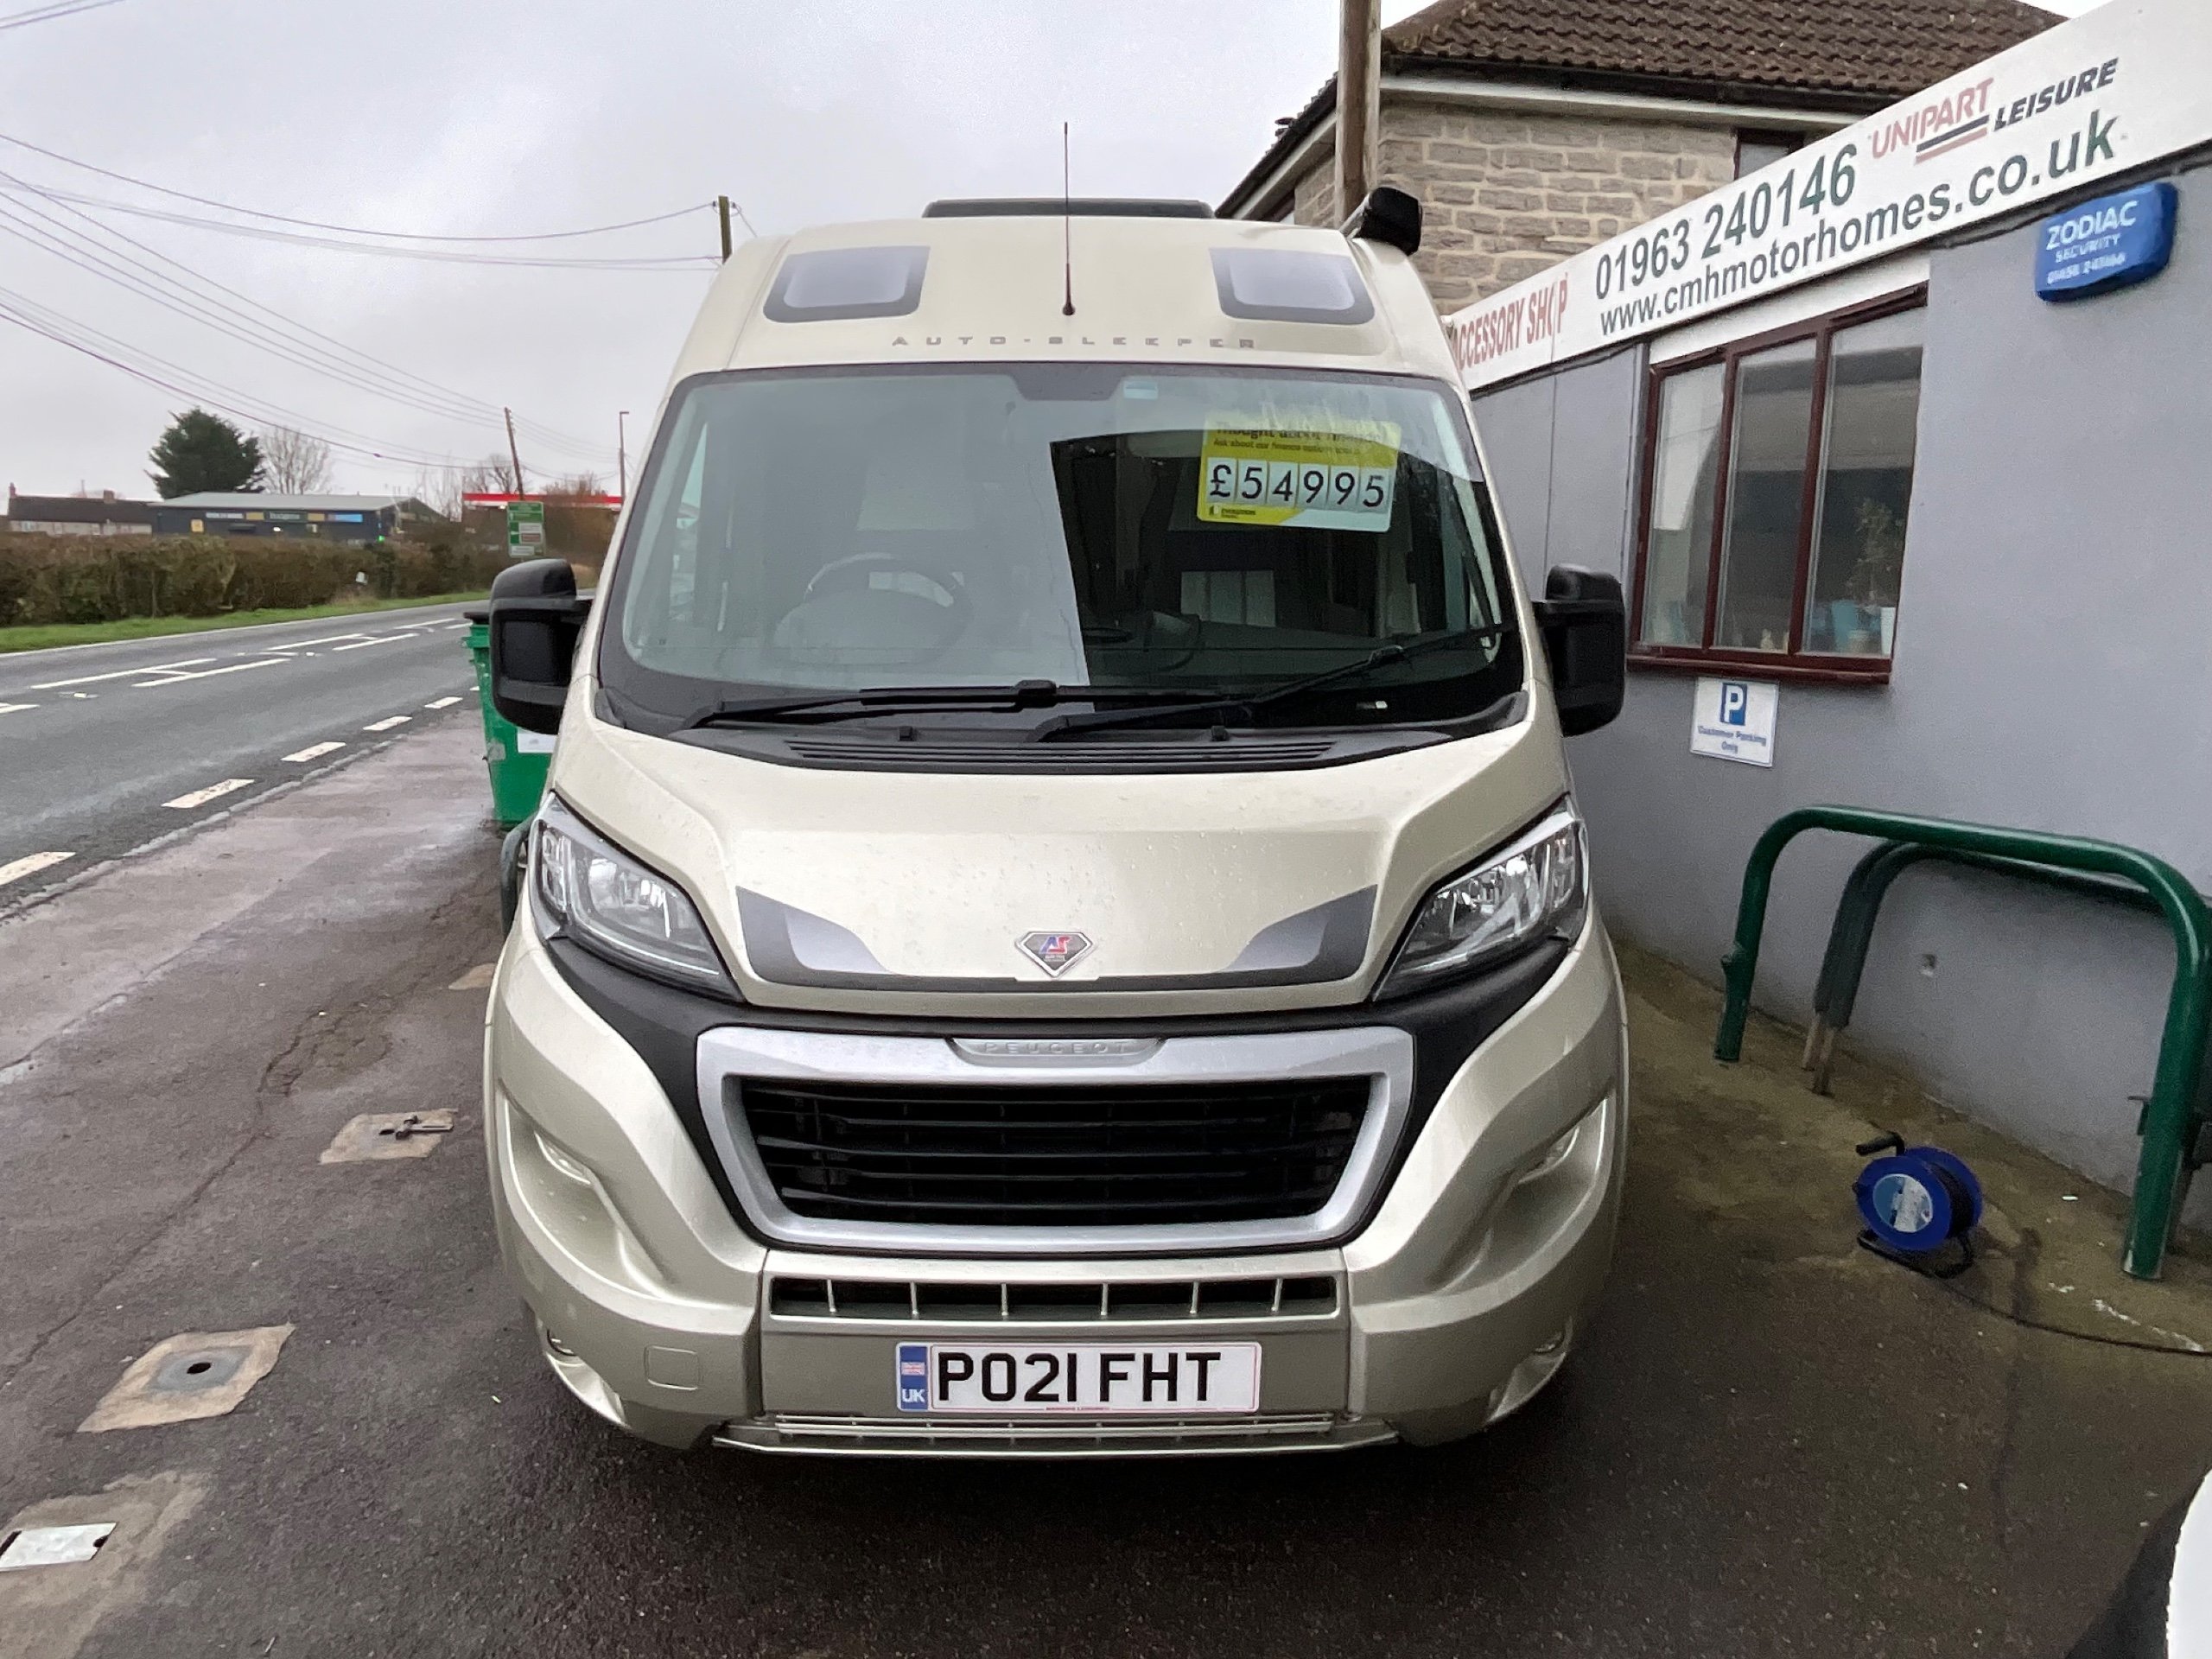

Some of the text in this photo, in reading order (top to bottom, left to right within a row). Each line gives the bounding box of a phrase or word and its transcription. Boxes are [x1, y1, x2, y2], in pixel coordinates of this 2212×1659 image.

[1872, 58, 2119, 159] UNIPART LEISURE
[1596, 143, 1858, 299] 01963 240146
[1600, 110, 2119, 334] www.cmhmotorhomes.co.uk
[2046, 200, 2139, 250] ZODIAC
[2056, 233, 2121, 263] SECURITY
[892, 336, 1255, 349] AUTO-SLEEPER
[1210, 464, 1385, 508] £54995
[1724, 684, 1744, 723] P
[985, 1041, 1128, 1054] PEUGEOT
[902, 1389, 925, 1403] UK
[938, 1352, 1221, 1402] PO21 FHT
